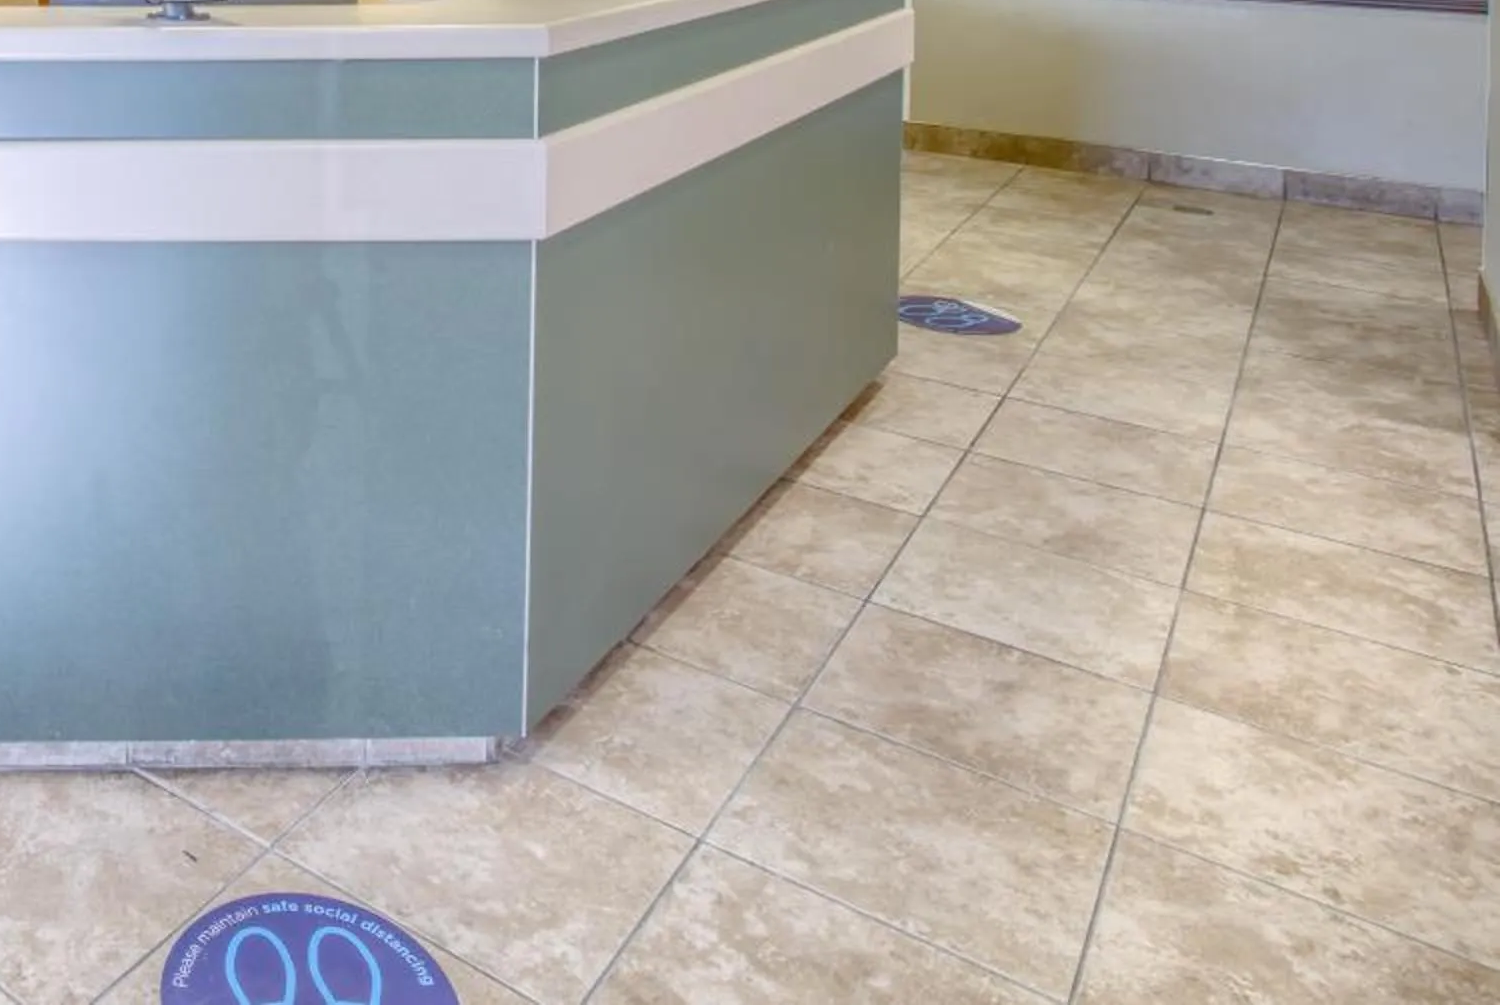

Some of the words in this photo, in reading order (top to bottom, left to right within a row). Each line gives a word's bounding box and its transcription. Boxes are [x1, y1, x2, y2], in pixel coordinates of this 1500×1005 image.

[172, 943, 201, 989] Please
[197, 906, 259, 946] maintain
[261, 900, 299, 914] safe
[304, 902, 358, 925] social
[361, 918, 436, 987] distancing
